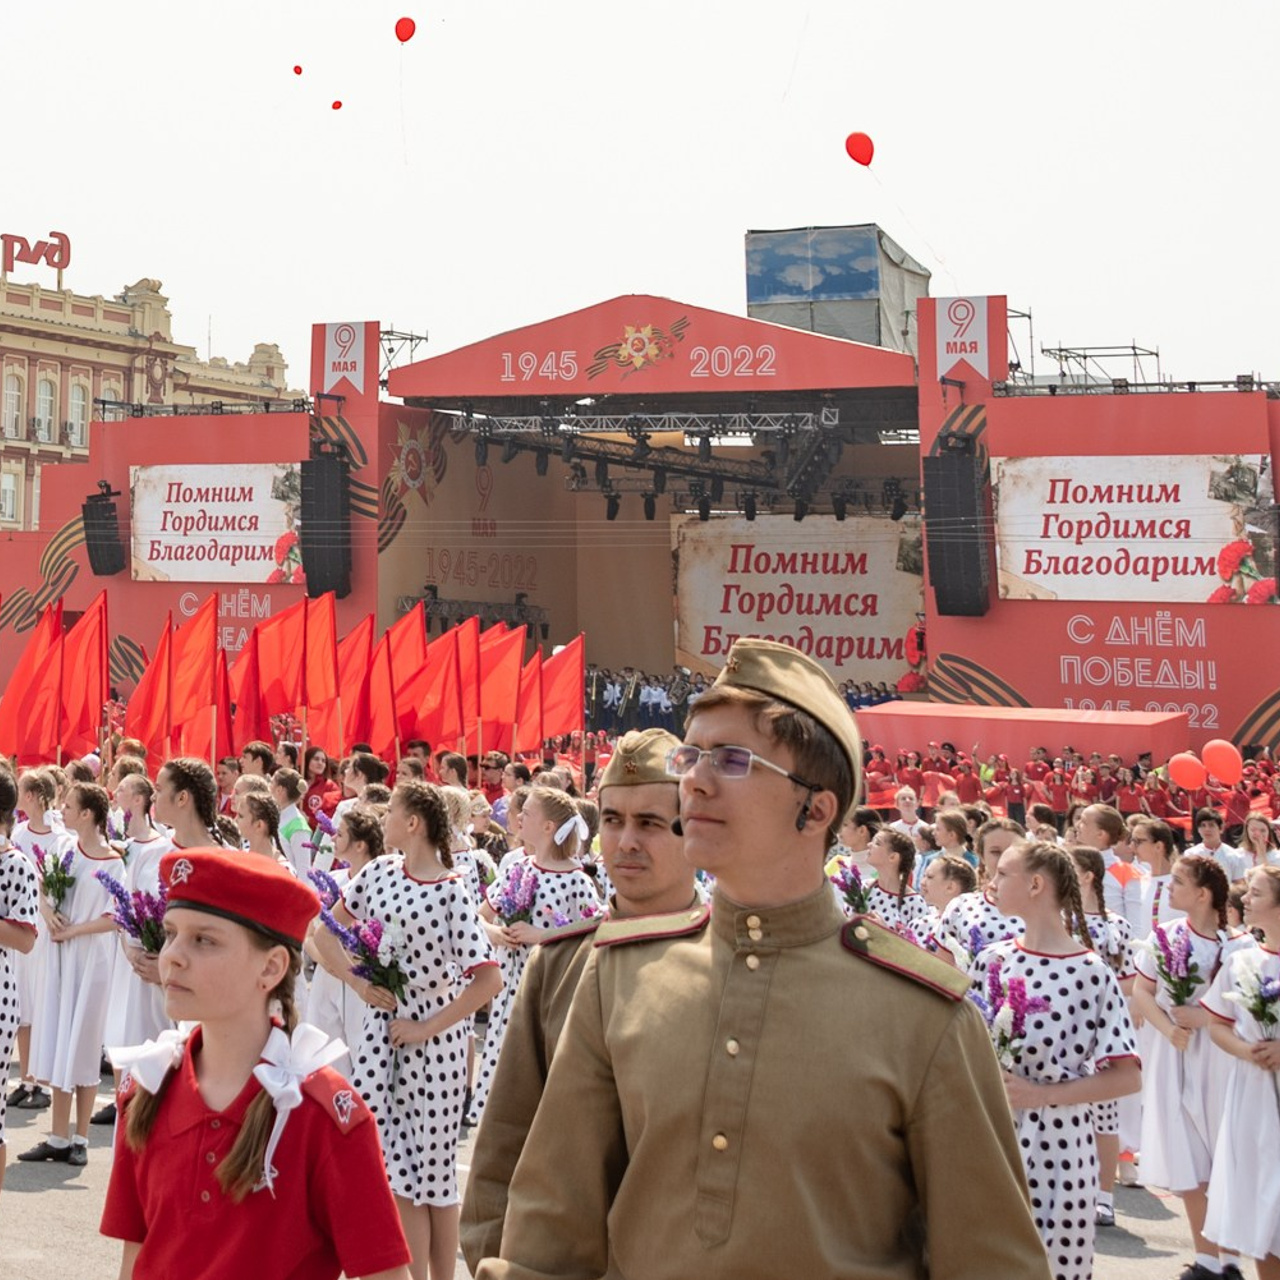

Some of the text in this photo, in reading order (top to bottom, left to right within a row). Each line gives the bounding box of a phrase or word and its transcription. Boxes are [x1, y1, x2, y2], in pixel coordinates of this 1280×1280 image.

[948, 299, 975, 338] 9
[334, 324, 355, 359] 9
[946, 341, 978, 354] МАЯ
[332, 361, 357, 372] МАЯ
[500, 350, 578, 381] 1945
[690, 344, 776, 377] 2022
[165, 482, 253, 503] Помним
[1046, 478, 1180, 504] Помним
[160, 509, 259, 536] Гордимся
[1040, 511, 1191, 545] Гордимся
[148, 539, 274, 566] Благодарим
[727, 544, 868, 575] Помним
[1023, 547, 1216, 582] Благодарим
[426, 547, 538, 591] 1945-2022
[218, 589, 271, 618] НЁМ
[720, 583, 879, 621] Гордимся
[1067, 611, 1206, 647] С ДНЁМ
[1060, 655, 1217, 690] ПОБЕДЫ!
